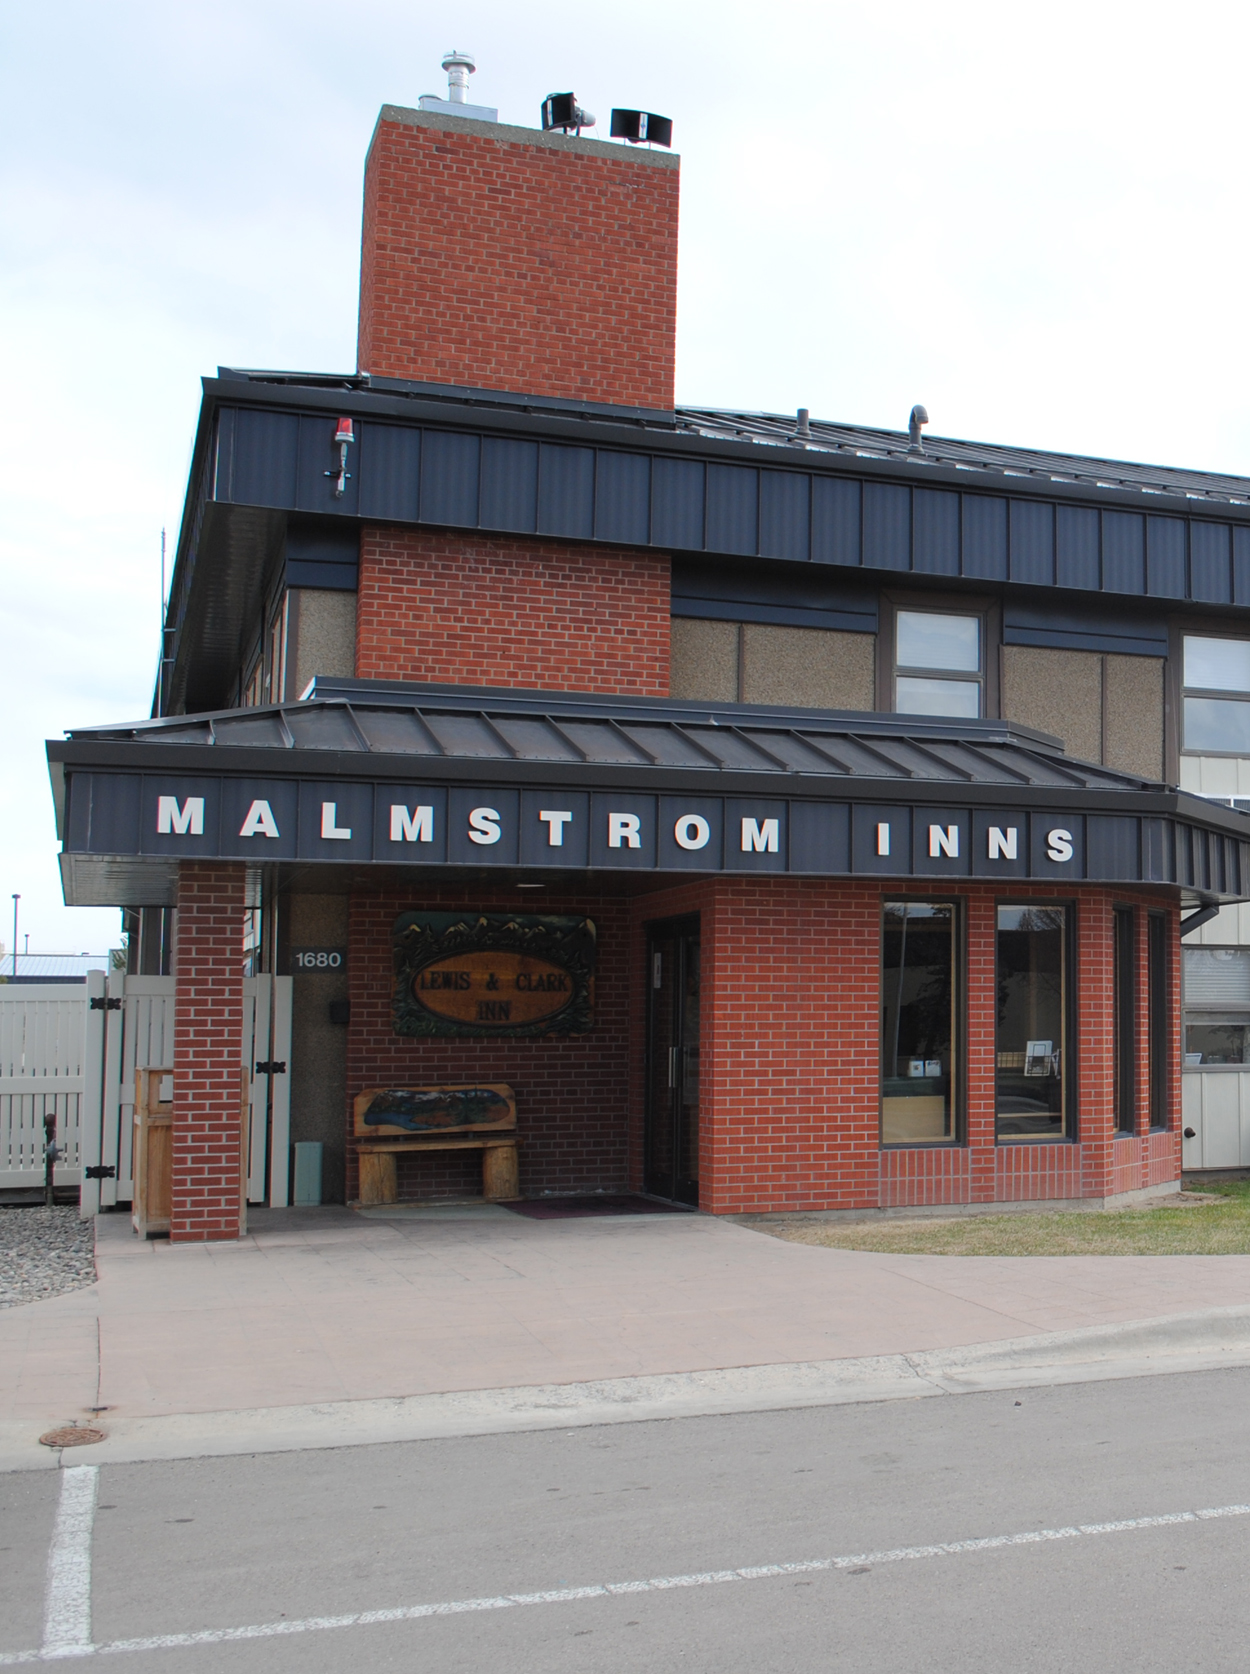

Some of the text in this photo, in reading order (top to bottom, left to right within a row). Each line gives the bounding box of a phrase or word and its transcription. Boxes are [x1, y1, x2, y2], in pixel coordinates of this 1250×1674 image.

[156, 795, 1073, 862] MALMSTROM INNS
[295, 952, 341, 967] 1680
[420, 970, 568, 992] LEWIS & CLARK
[477, 1001, 511, 1020] INN
